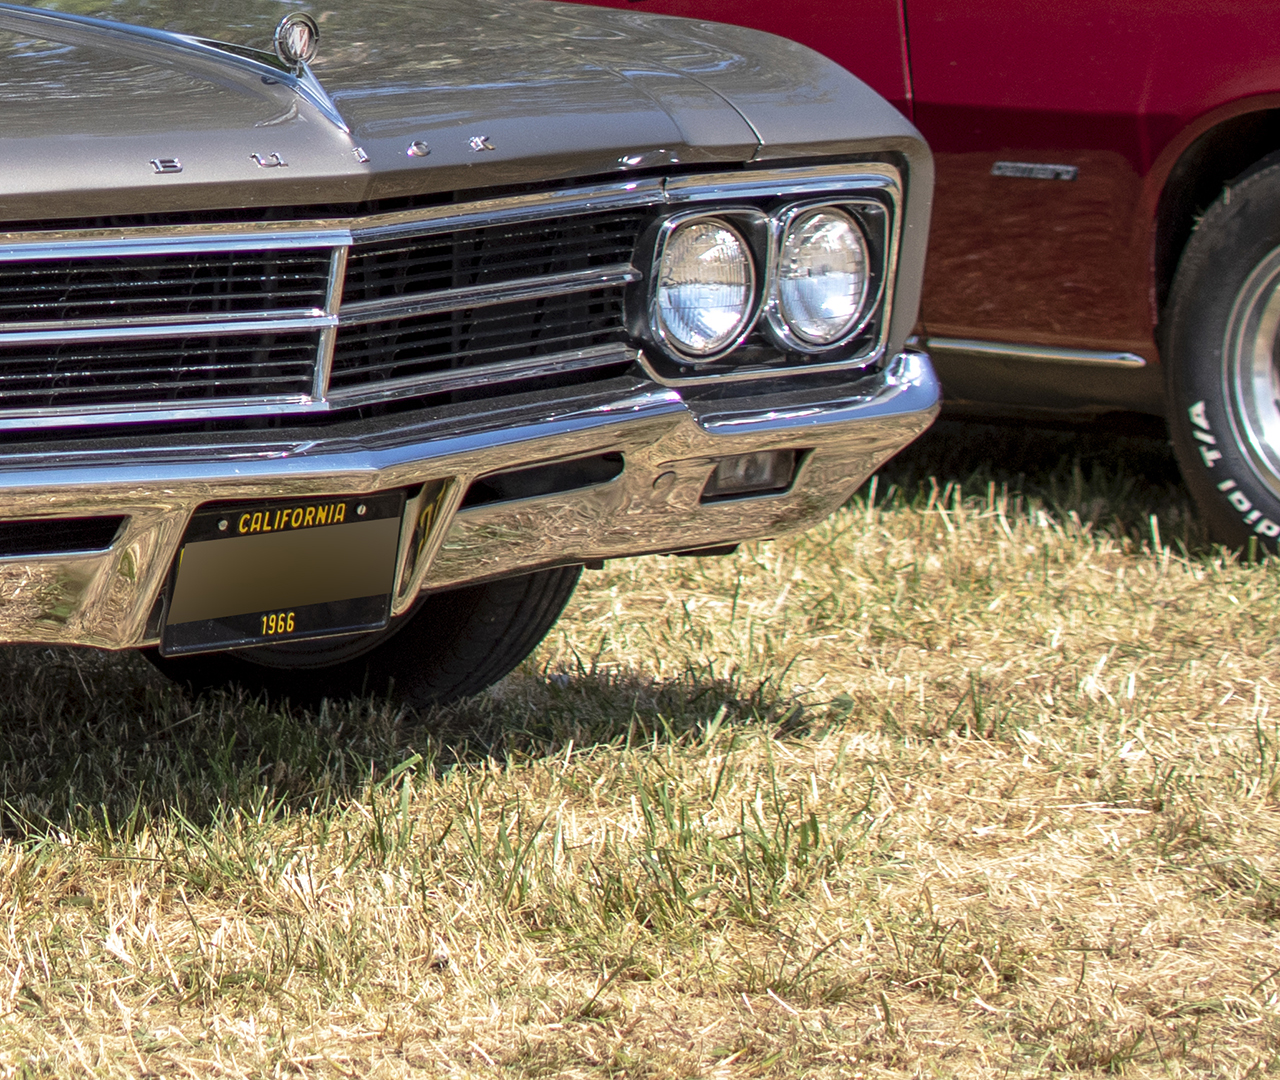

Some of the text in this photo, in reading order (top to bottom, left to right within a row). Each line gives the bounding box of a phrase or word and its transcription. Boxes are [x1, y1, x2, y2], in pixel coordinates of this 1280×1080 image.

[149, 136, 495, 174] BUICK
[1187, 400, 1280, 542] dial T/A
[238, 503, 347, 534] CALIFORNIA
[261, 612, 296, 636] 1966
